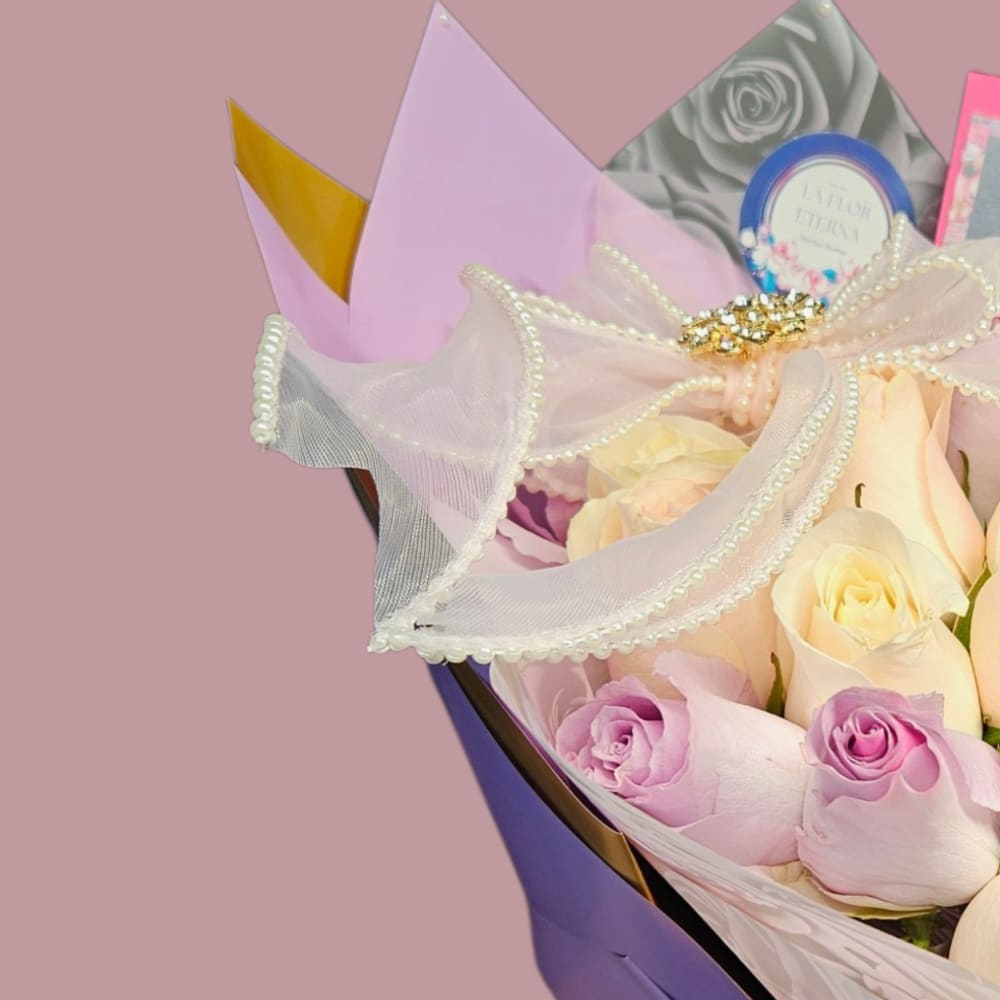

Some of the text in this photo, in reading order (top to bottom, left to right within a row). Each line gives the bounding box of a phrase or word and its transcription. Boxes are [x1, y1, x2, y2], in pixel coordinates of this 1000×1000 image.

[802, 183, 873, 222] LA FLOR
[796, 207, 860, 243] ETERNA
